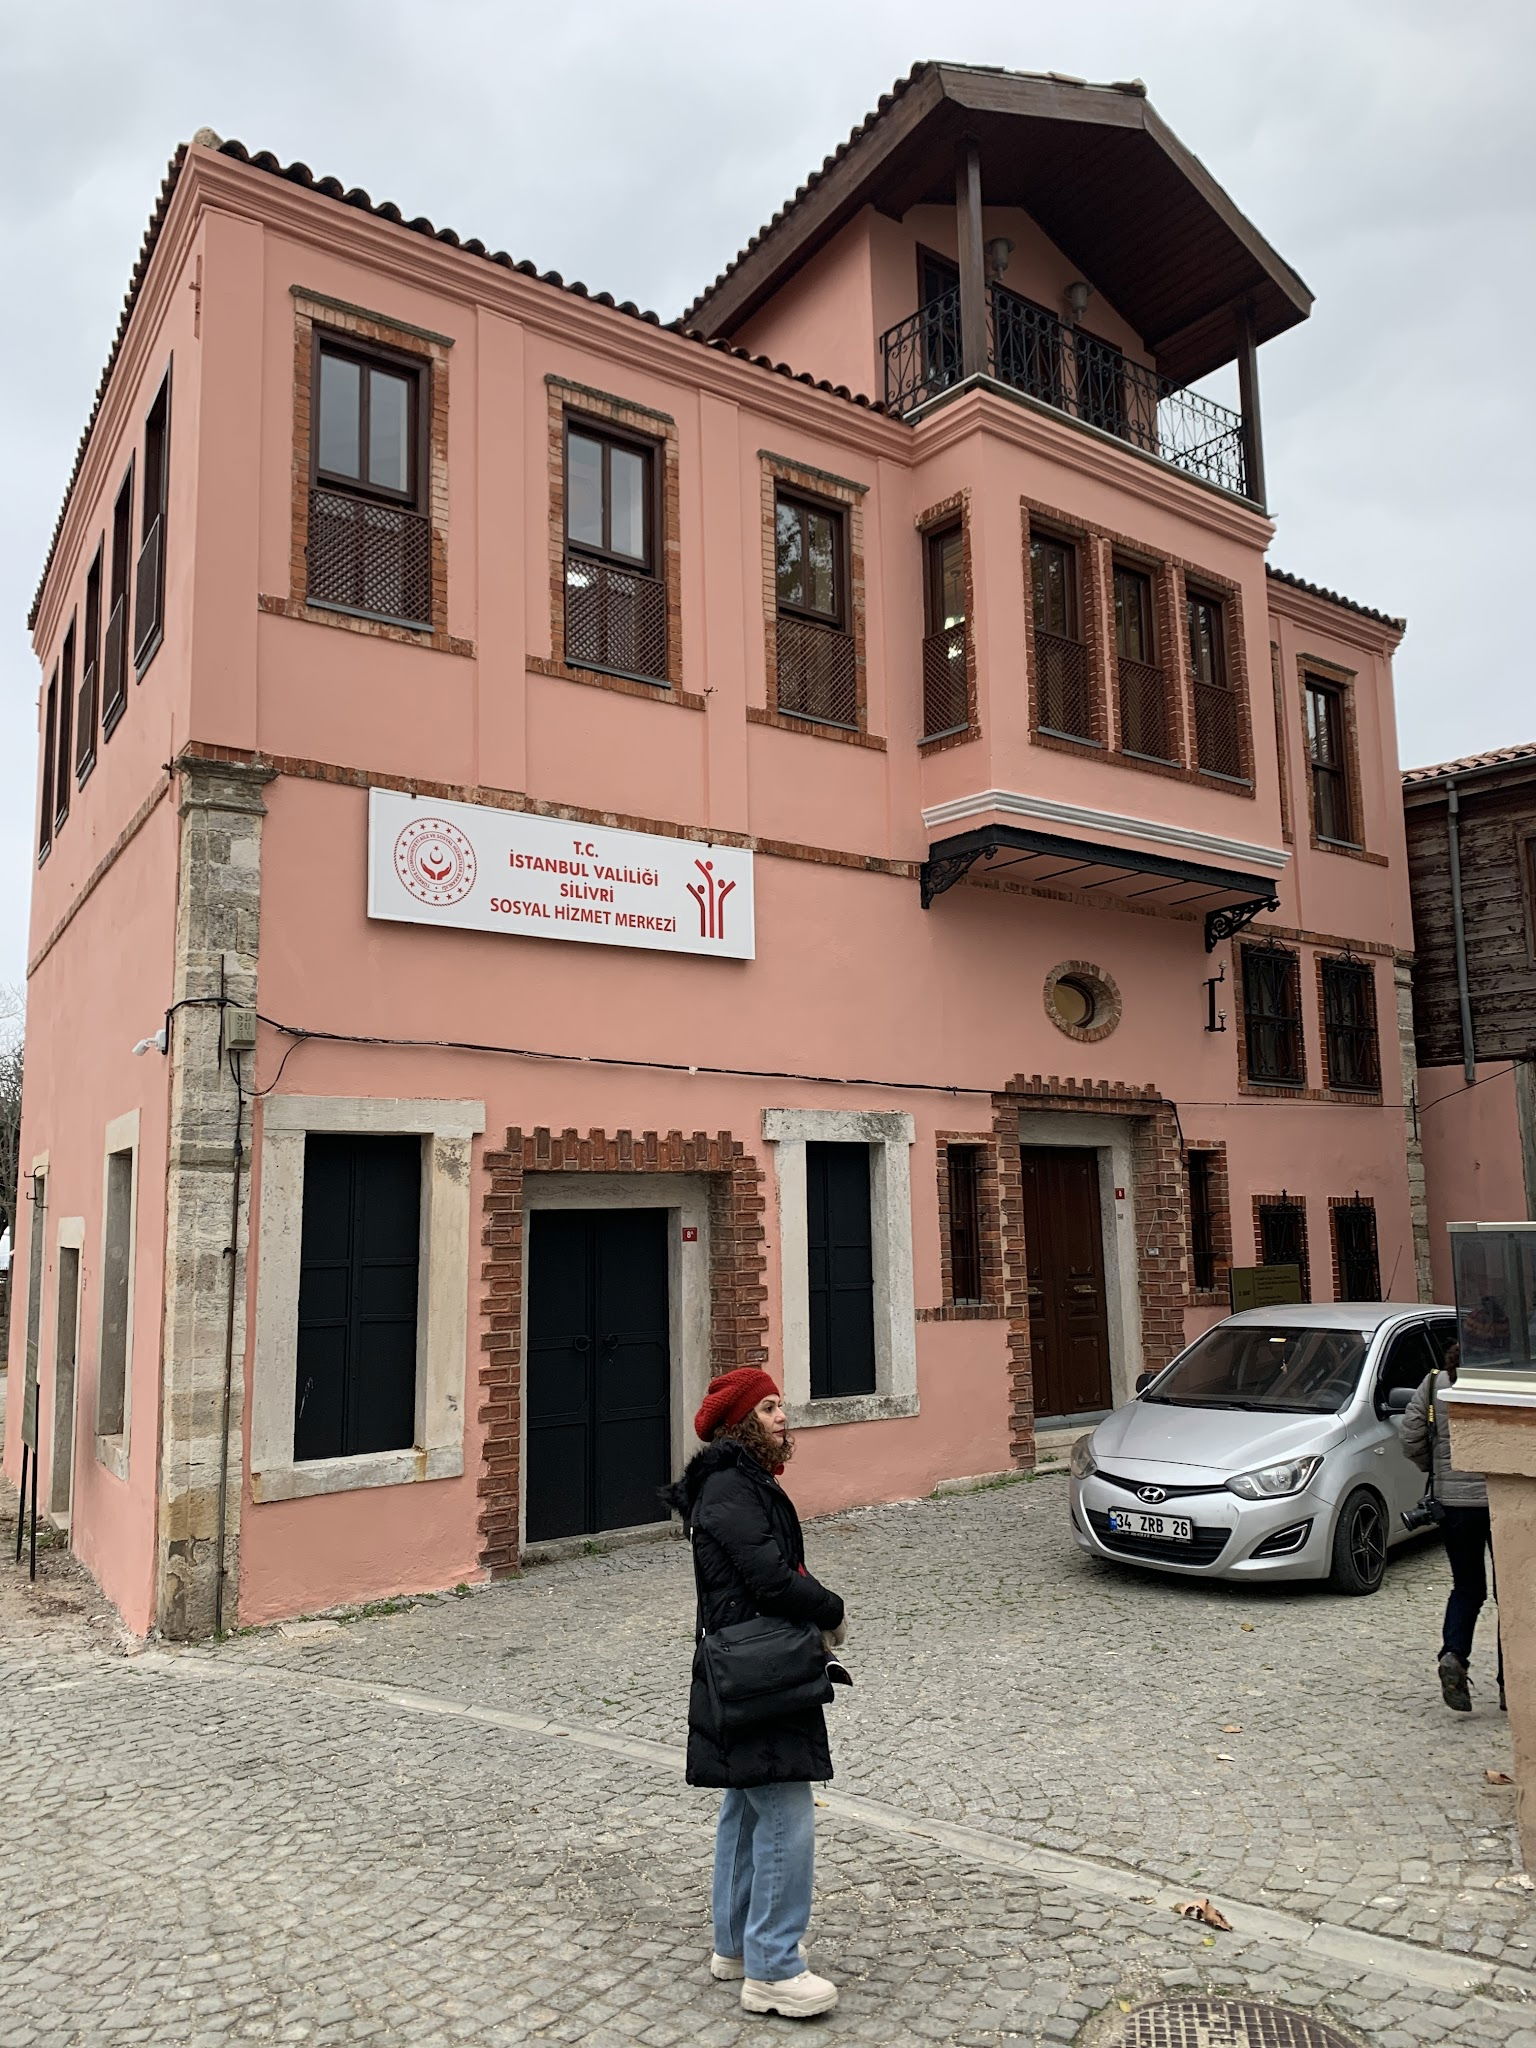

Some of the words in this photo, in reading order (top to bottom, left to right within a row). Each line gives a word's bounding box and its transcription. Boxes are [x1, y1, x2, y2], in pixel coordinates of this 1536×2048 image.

[573, 841, 599, 858] T.C.
[509, 849, 589, 877] İSTANBUL
[593, 865, 659, 887] VALİLİĞİ
[560, 880, 614, 903] SİLİVRİ
[490, 897, 551, 918] SOSYAL
[554, 904, 612, 925] HİZMET
[615, 912, 676, 933] MERKEZİ
[1116, 1513, 1132, 1530] 34
[1140, 1516, 1164, 1533] ZRB
[1172, 1520, 1188, 1537] 26
